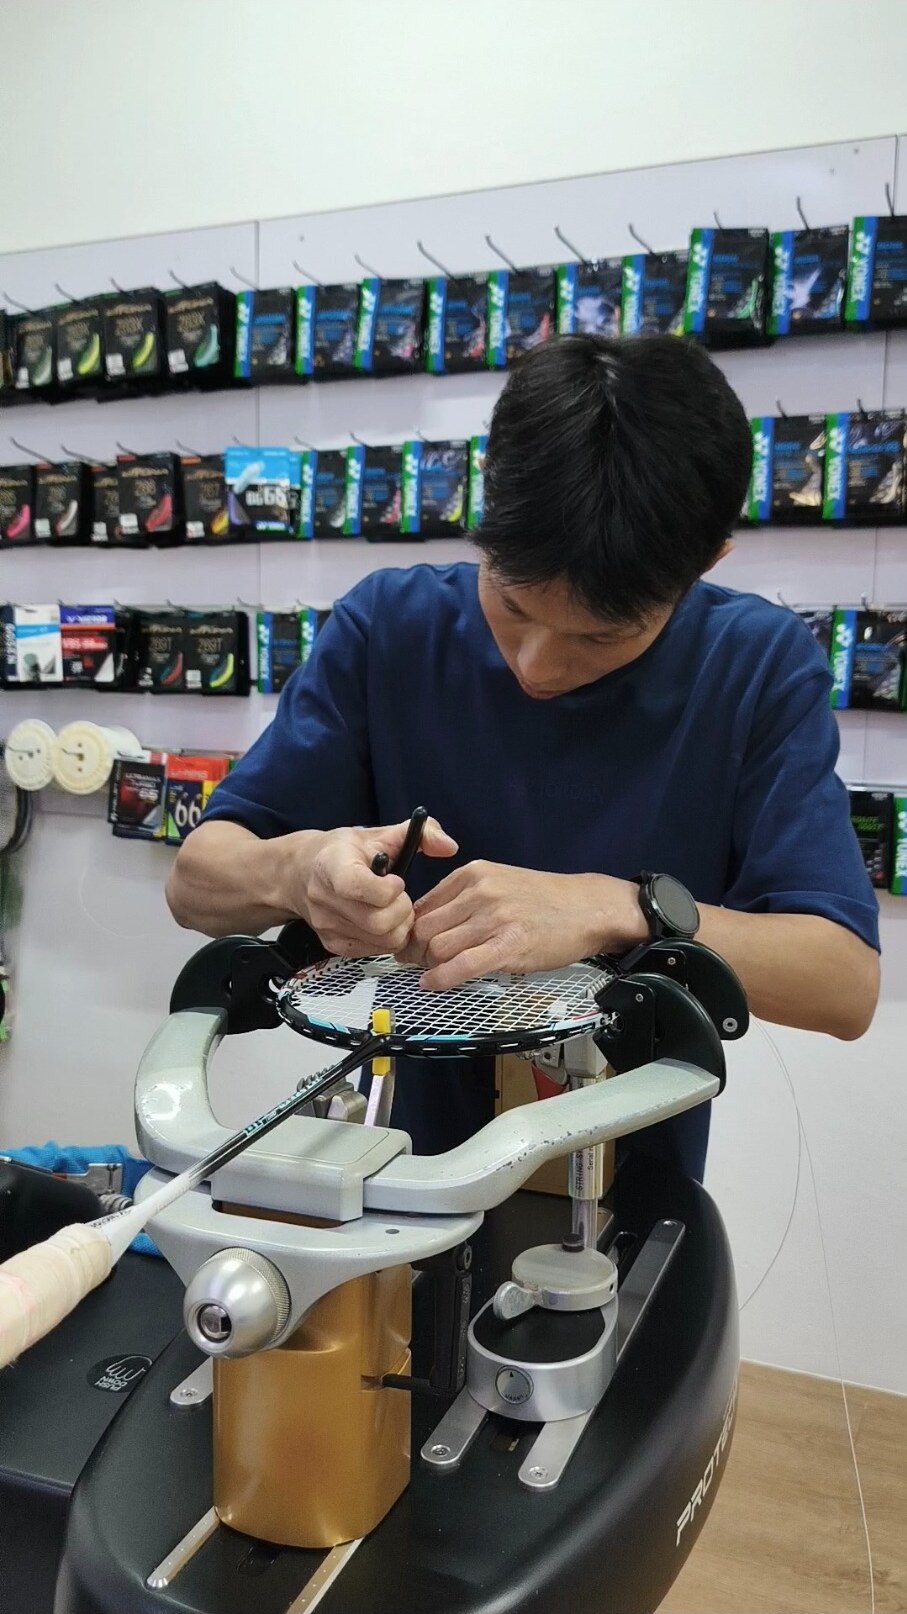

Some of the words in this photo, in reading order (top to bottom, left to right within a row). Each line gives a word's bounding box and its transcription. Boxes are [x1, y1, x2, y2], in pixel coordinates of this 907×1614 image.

[832, 649, 849, 692] YONEX
[94, 1380, 121, 1391] PUSH
[99, 1376, 127, 1387] DOWN
